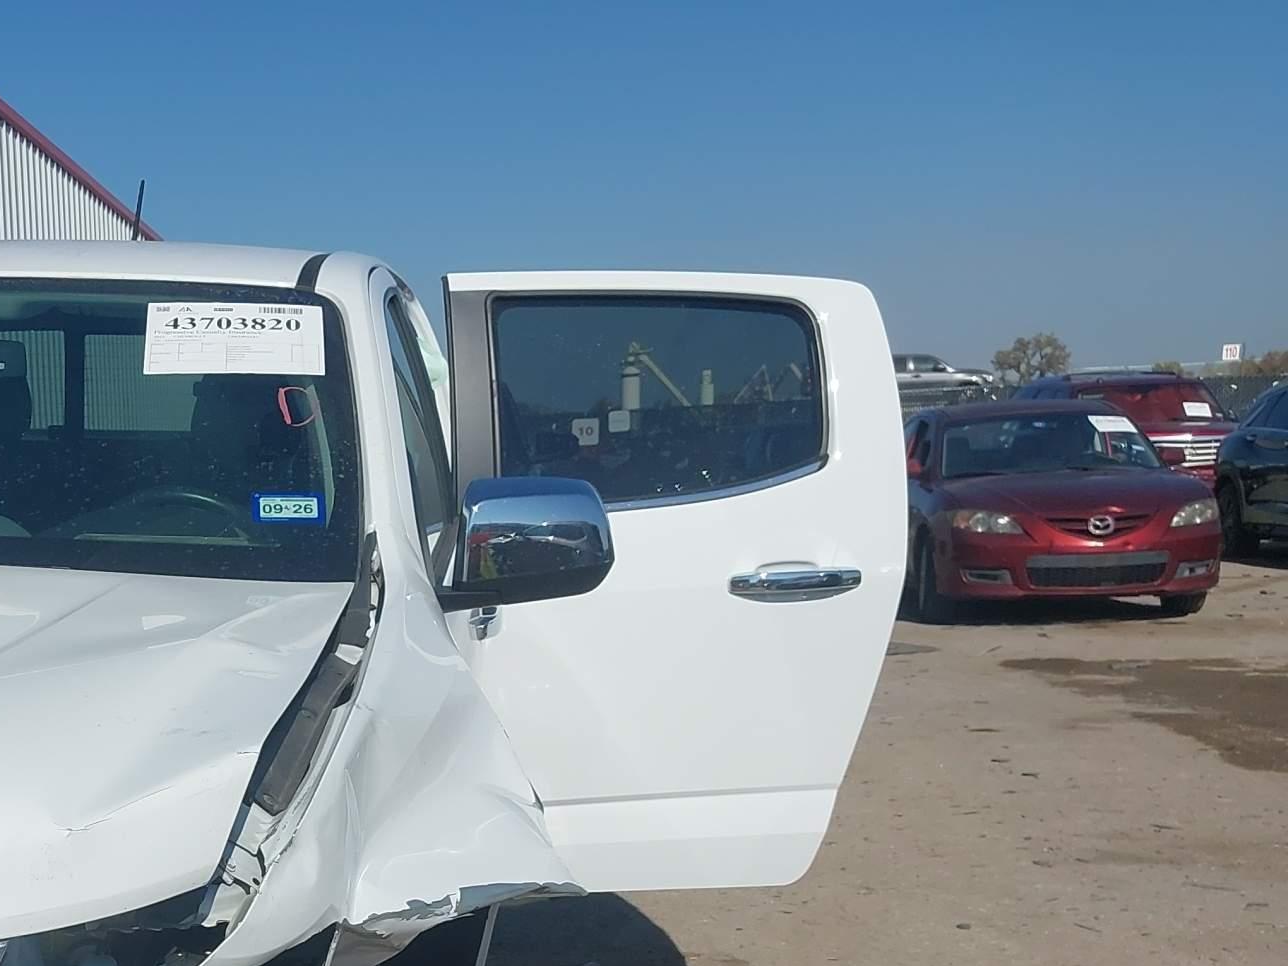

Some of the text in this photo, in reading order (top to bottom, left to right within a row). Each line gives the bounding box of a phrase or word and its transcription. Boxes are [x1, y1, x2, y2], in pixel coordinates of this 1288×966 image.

[165, 317, 301, 331] 43703820
[1225, 346, 1238, 358] 110
[262, 503, 314, 514] 09 26
